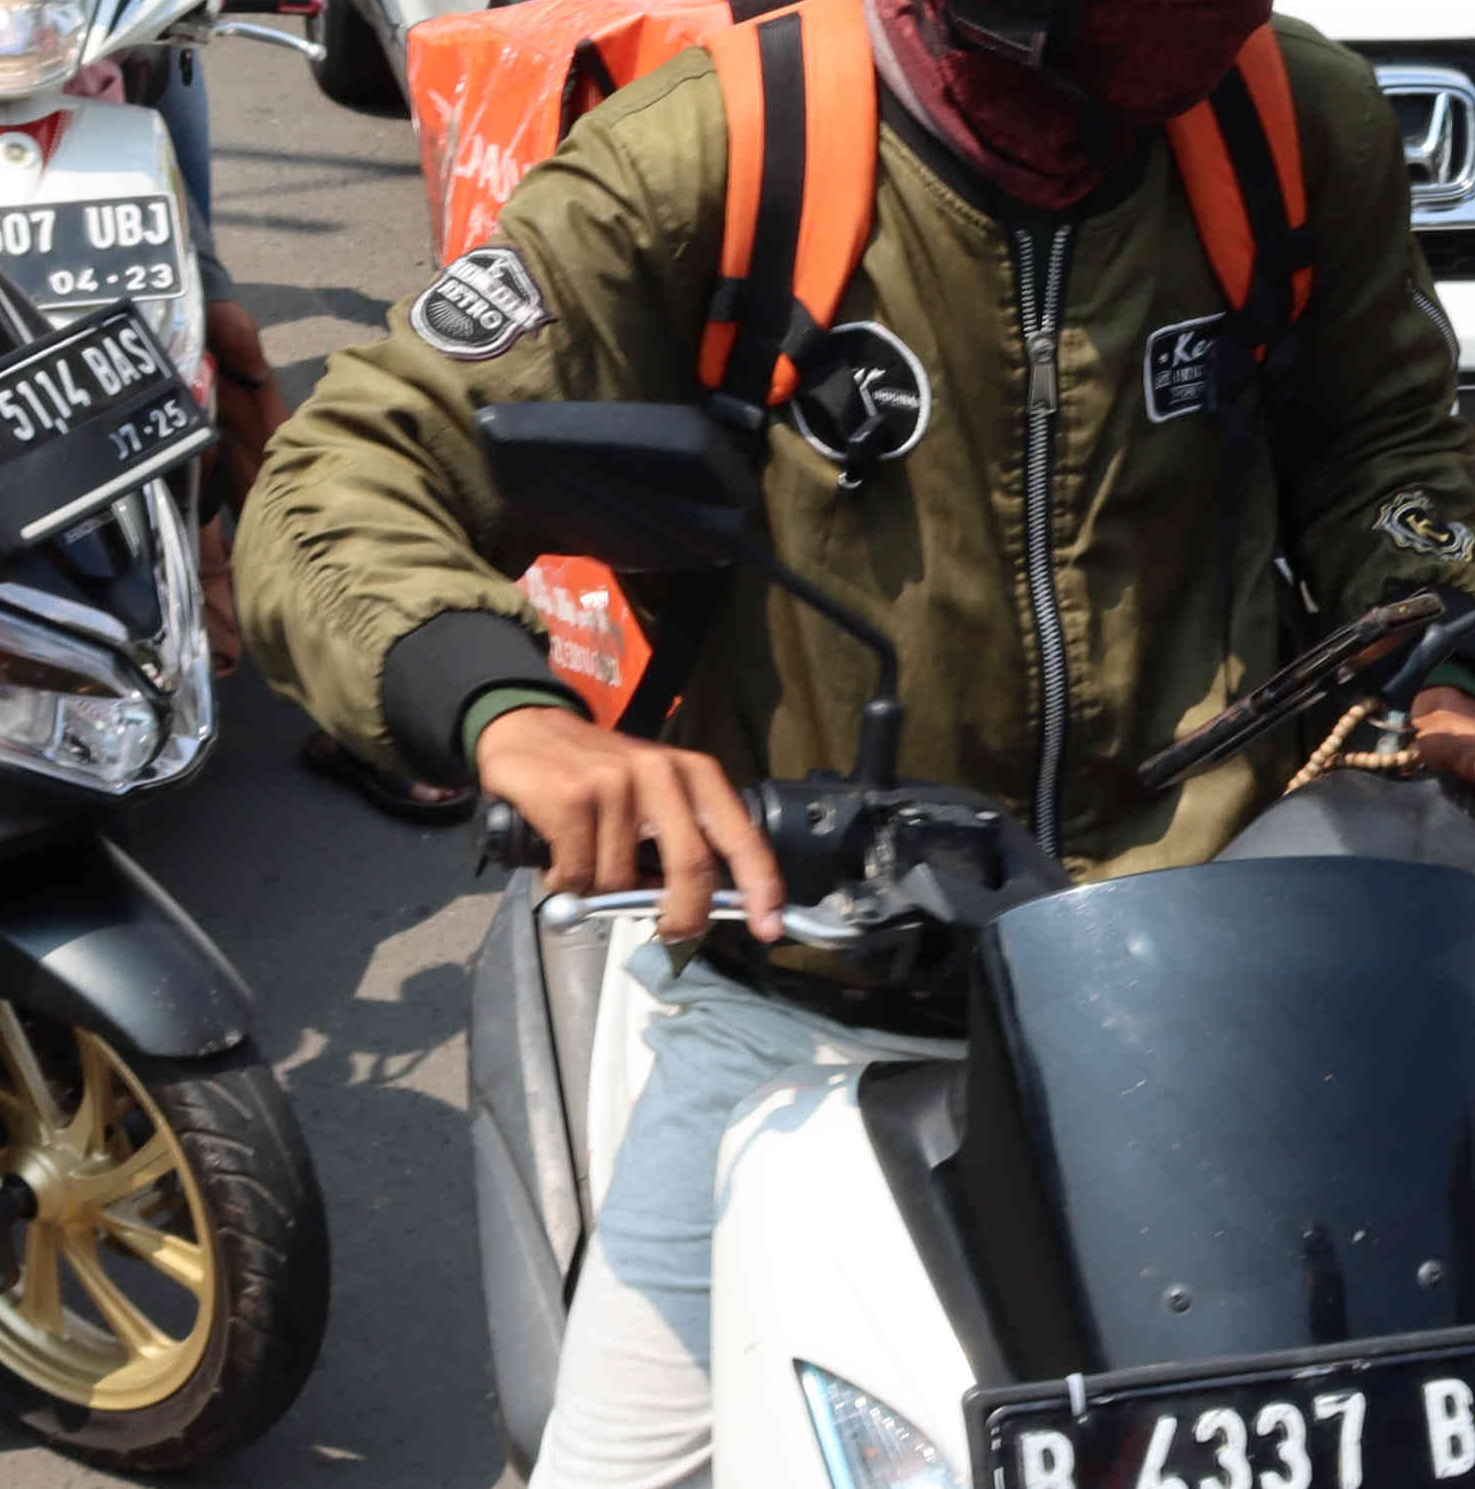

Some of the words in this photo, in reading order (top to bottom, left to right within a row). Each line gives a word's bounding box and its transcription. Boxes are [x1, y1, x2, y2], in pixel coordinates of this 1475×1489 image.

[84, 202, 170, 250] UBJ
[81, 327, 158, 397] BAS
[1020, 1431, 1076, 1489] B
